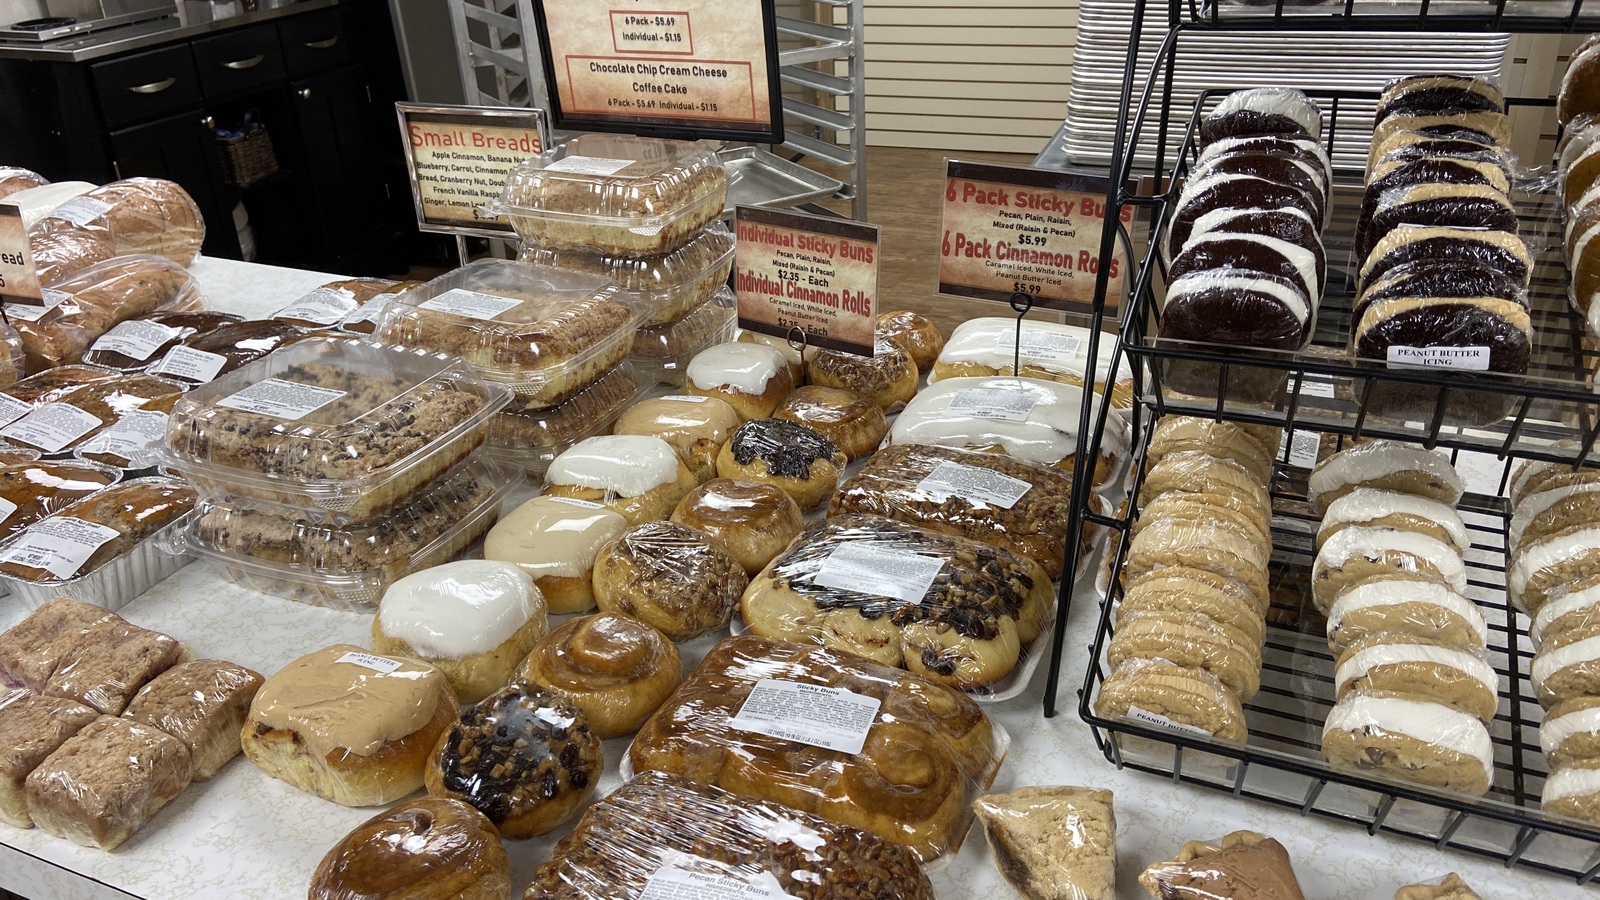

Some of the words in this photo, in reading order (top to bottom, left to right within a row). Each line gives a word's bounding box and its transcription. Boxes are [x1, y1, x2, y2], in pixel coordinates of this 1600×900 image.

[625, 17, 630, 25] 6
[630, 17, 650, 26] Pack
[655, 16, 675, 26] $5.69
[622, 32, 658, 42] Individual
[665, 32, 682, 42] $1.15
[590, 62, 636, 74] Chocolate
[636, 64, 658, 77] Chip
[659, 66, 691, 76] Cream
[692, 66, 728, 78] Cheese
[633, 82, 662, 94] Coffee
[664, 84, 688, 95] Cake
[608, 99, 612, 107] 6
[613, 99, 631, 108] Pack
[636, 99, 656, 109] $5.69
[660, 101, 694, 111] Individual
[701, 102, 718, 112] $1.15
[410, 125, 466, 148] Small
[472, 132, 542, 155] Breads
[432, 151, 450, 160] Apple
[452, 153, 486, 162] Cinnamon,
[488, 154, 512, 164] Banana
[416, 162, 450, 172] Blueberry,
[451, 164, 474, 174] Carrot,
[475, 166, 508, 175] Cinnamon
[418, 174, 439, 182] Bread,
[440, 175, 473, 186] Cranberry
[474, 178, 488, 186] Nut,
[434, 186, 456, 196] French
[456, 188, 478, 196] Vanilla
[424, 198, 447, 207] Ginger,
[448, 198, 470, 208] Lemon
[946, 178, 958, 203] 6
[963, 182, 1010, 208] Pack
[1015, 191, 1075, 218] Sticky
[1080, 197, 1132, 222] Bus
[998, 210, 1024, 220] Pecan,
[1024, 213, 1046, 224] Plain,
[1047, 216, 1072, 226] Raisin,
[992, 221, 1014, 230] Mixed
[1016, 223, 1041, 234] (Raisin
[1050, 227, 1076, 238] Pecan)
[736, 222, 794, 248] Individual
[798, 235, 836, 259] Sticky
[840, 240, 874, 264] Buns
[1018, 234, 1047, 246] $5.99
[0, 252, 24, 266] ead
[776, 250, 795, 260] Pecan,
[796, 252, 812, 263] Plain,
[813, 256, 832, 266] Raisin,
[942, 230, 950, 257] 6
[955, 232, 992, 260] Pack
[996, 240, 1074, 270] Cinnamon
[1078, 250, 1120, 279] Ros
[772, 259, 788, 269] Mixed
[790, 262, 808, 272] (Raisin
[816, 268, 836, 278] Pecan)
[986, 260, 1015, 270] Caramel
[1016, 264, 1034, 274] Iced,
[1036, 266, 1056, 276] White
[1058, 269, 1074, 279] Iced,
[778, 270, 800, 282] $2.35
[808, 276, 828, 288] Each
[996, 270, 1020, 281] Peanut
[1022, 274, 1044, 284] Butter
[1046, 276, 1062, 286] Iced
[736, 267, 784, 297] Individual
[786, 280, 840, 309] Cinnamon
[842, 289, 871, 318] Rolls
[1013, 282, 1041, 295] $5.99
[770, 296, 792, 308] Caramel
[793, 300, 806, 311] Iced,
[806, 304, 822, 315] White
[824, 306, 838, 318] Iced,
[778, 308, 797, 318] Peanut
[798, 312, 816, 321] Butter
[817, 315, 828, 324] Iced
[808, 324, 828, 336] Each
[1398, 349, 1438, 358] PEANUT
[1440, 349, 1480, 358] BUTTER
[372, 657, 396, 666] BUTTER
[797, 684, 819, 692] Sticky
[820, 688, 840, 696] Buns
[1136, 713, 1167, 726] PEANUT
[688, 872, 716, 884] Pecan
[717, 877, 746, 890] Sticky
[746, 885, 770, 897] Buns
